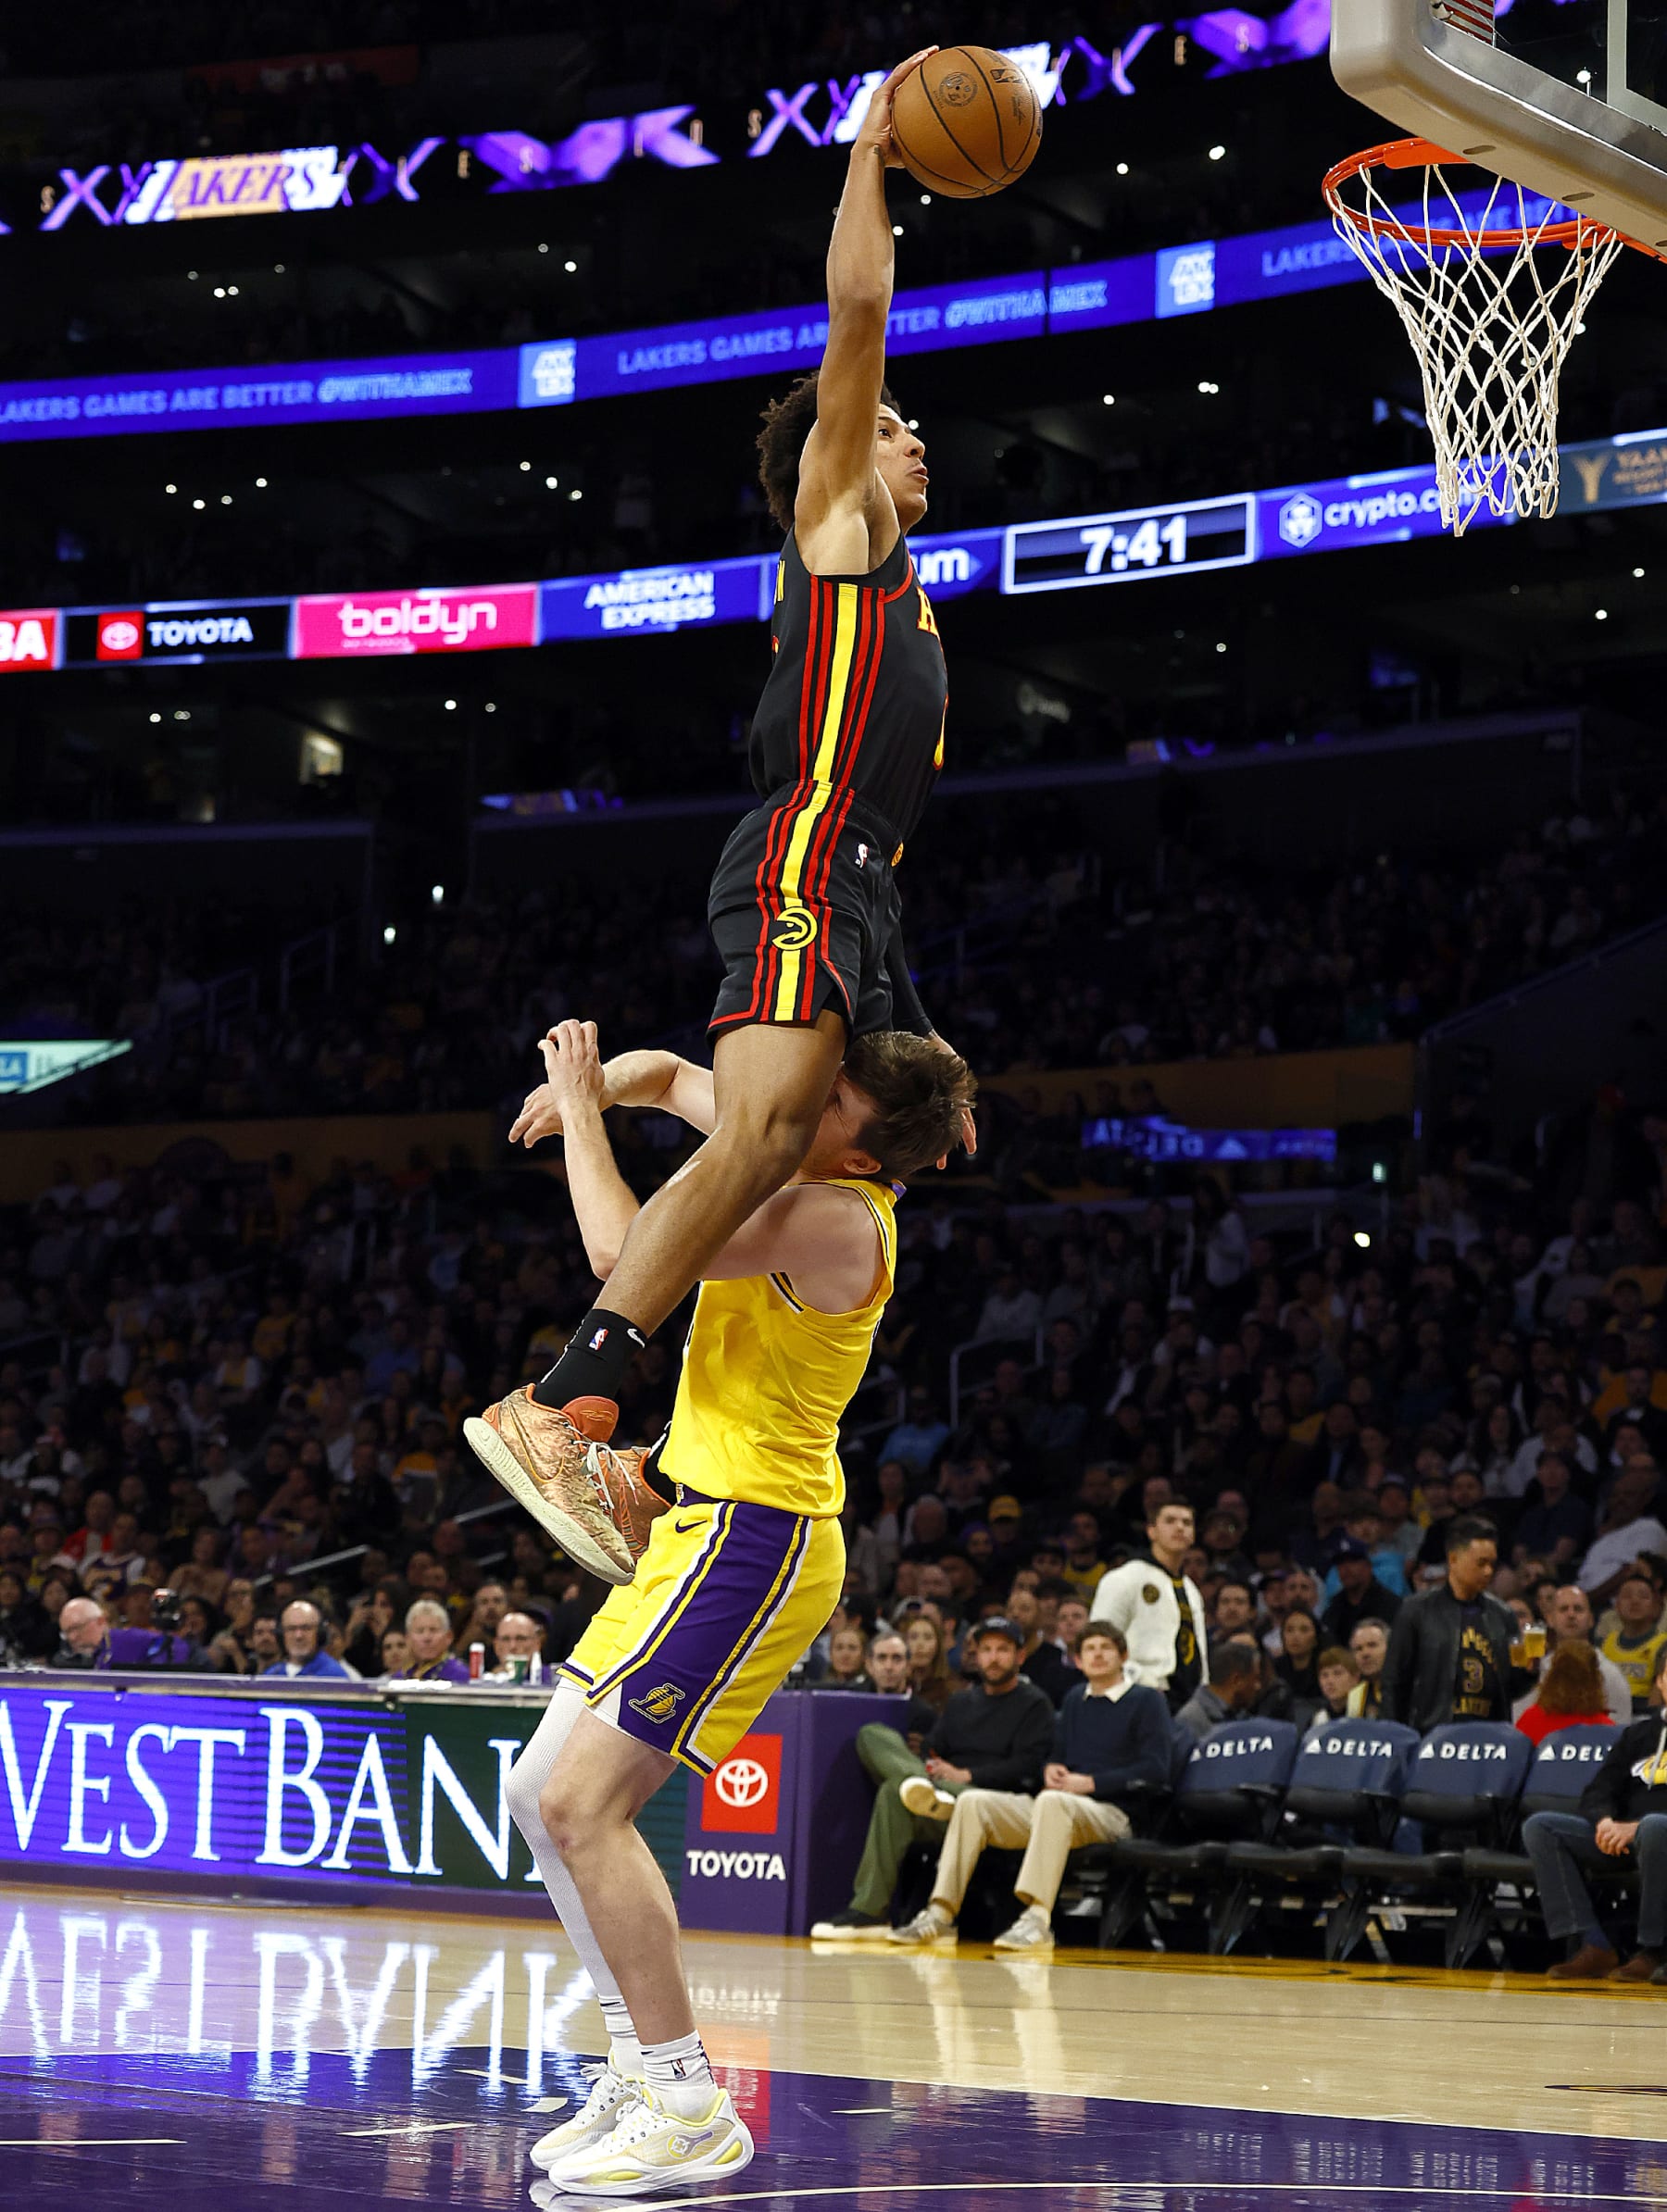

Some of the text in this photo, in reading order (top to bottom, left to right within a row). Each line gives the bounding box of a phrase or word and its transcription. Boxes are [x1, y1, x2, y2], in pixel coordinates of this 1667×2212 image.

[618, 339, 707, 375] LAKERS
[796, 321, 829, 349] AR
[884, 306, 940, 336] TTER
[0, 395, 80, 423] AKERS
[1081, 514, 1187, 574] 7:41
[909, 547, 970, 585] um
[584, 570, 714, 609] AMERICAN
[337, 597, 498, 645] boldyn
[602, 595, 716, 631] EXPRESS
[146, 617, 255, 646] TOYOTA
[1206, 1736, 1273, 1758] DELTA
[1326, 1738, 1393, 1757] DELTA
[1440, 1742, 1507, 1760] DELTA
[1560, 1744, 1611, 1761] DEL
[255, 1707, 539, 1881] BAN
[686, 1850, 786, 1881] TOYOTA
